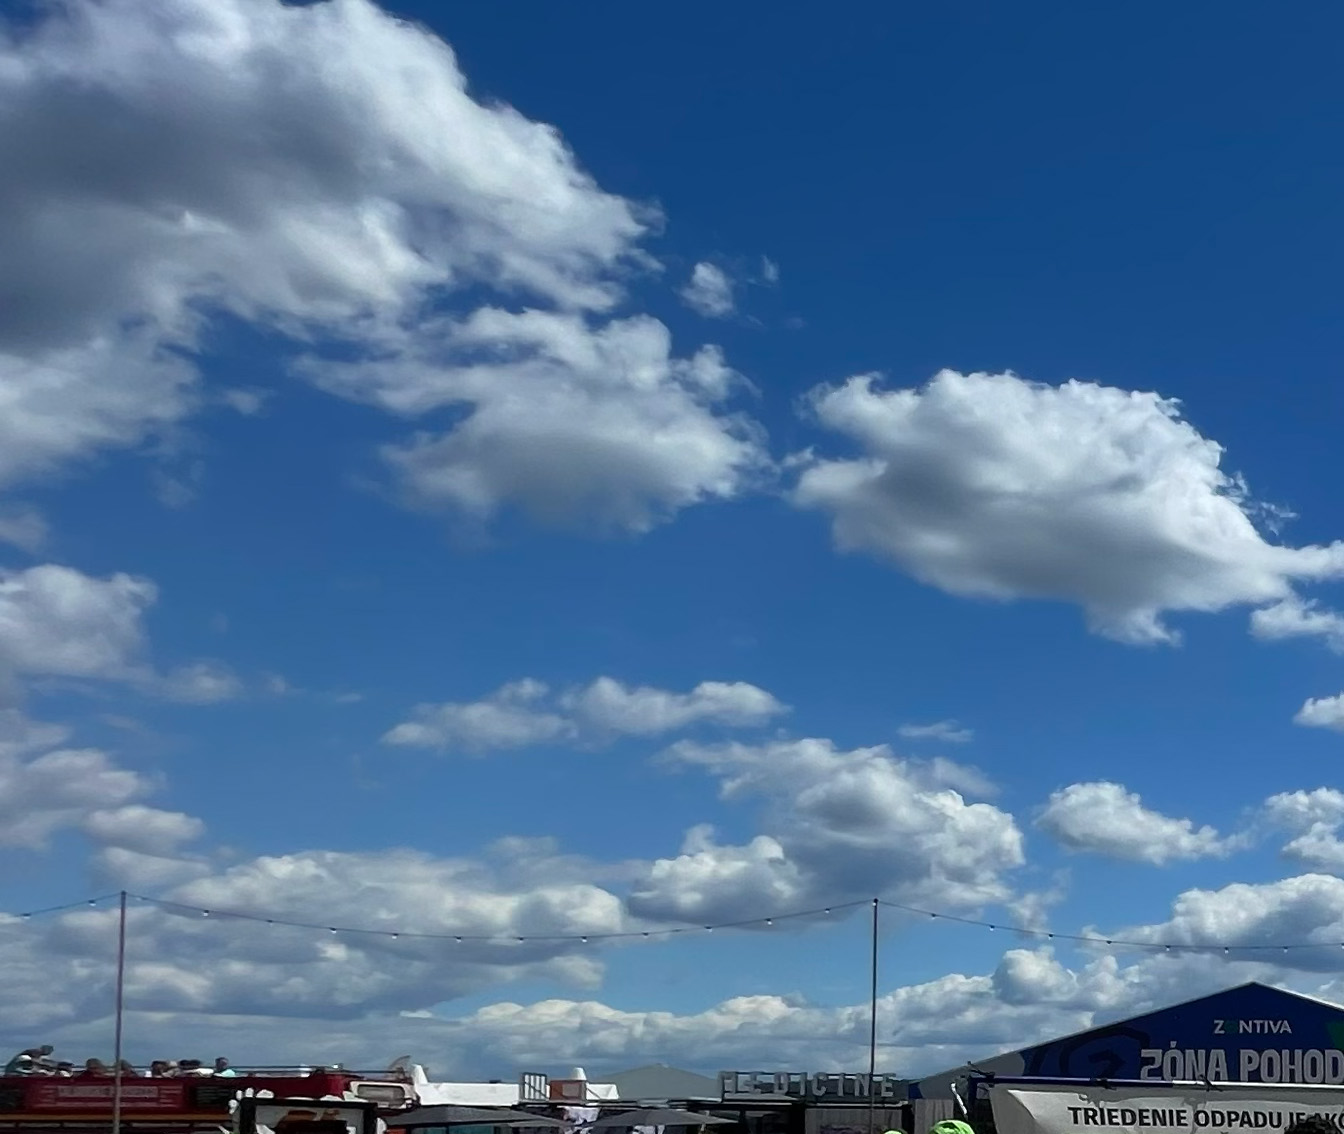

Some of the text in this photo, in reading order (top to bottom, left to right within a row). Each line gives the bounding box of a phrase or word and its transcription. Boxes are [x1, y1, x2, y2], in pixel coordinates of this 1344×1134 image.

[1140, 1041, 1228, 1081] ZÓNA
[718, 1071, 896, 1097] MEDICINE
[1068, 1106, 1189, 1127] TRIEDENIE
[1193, 1109, 1283, 1129] ODPADU
